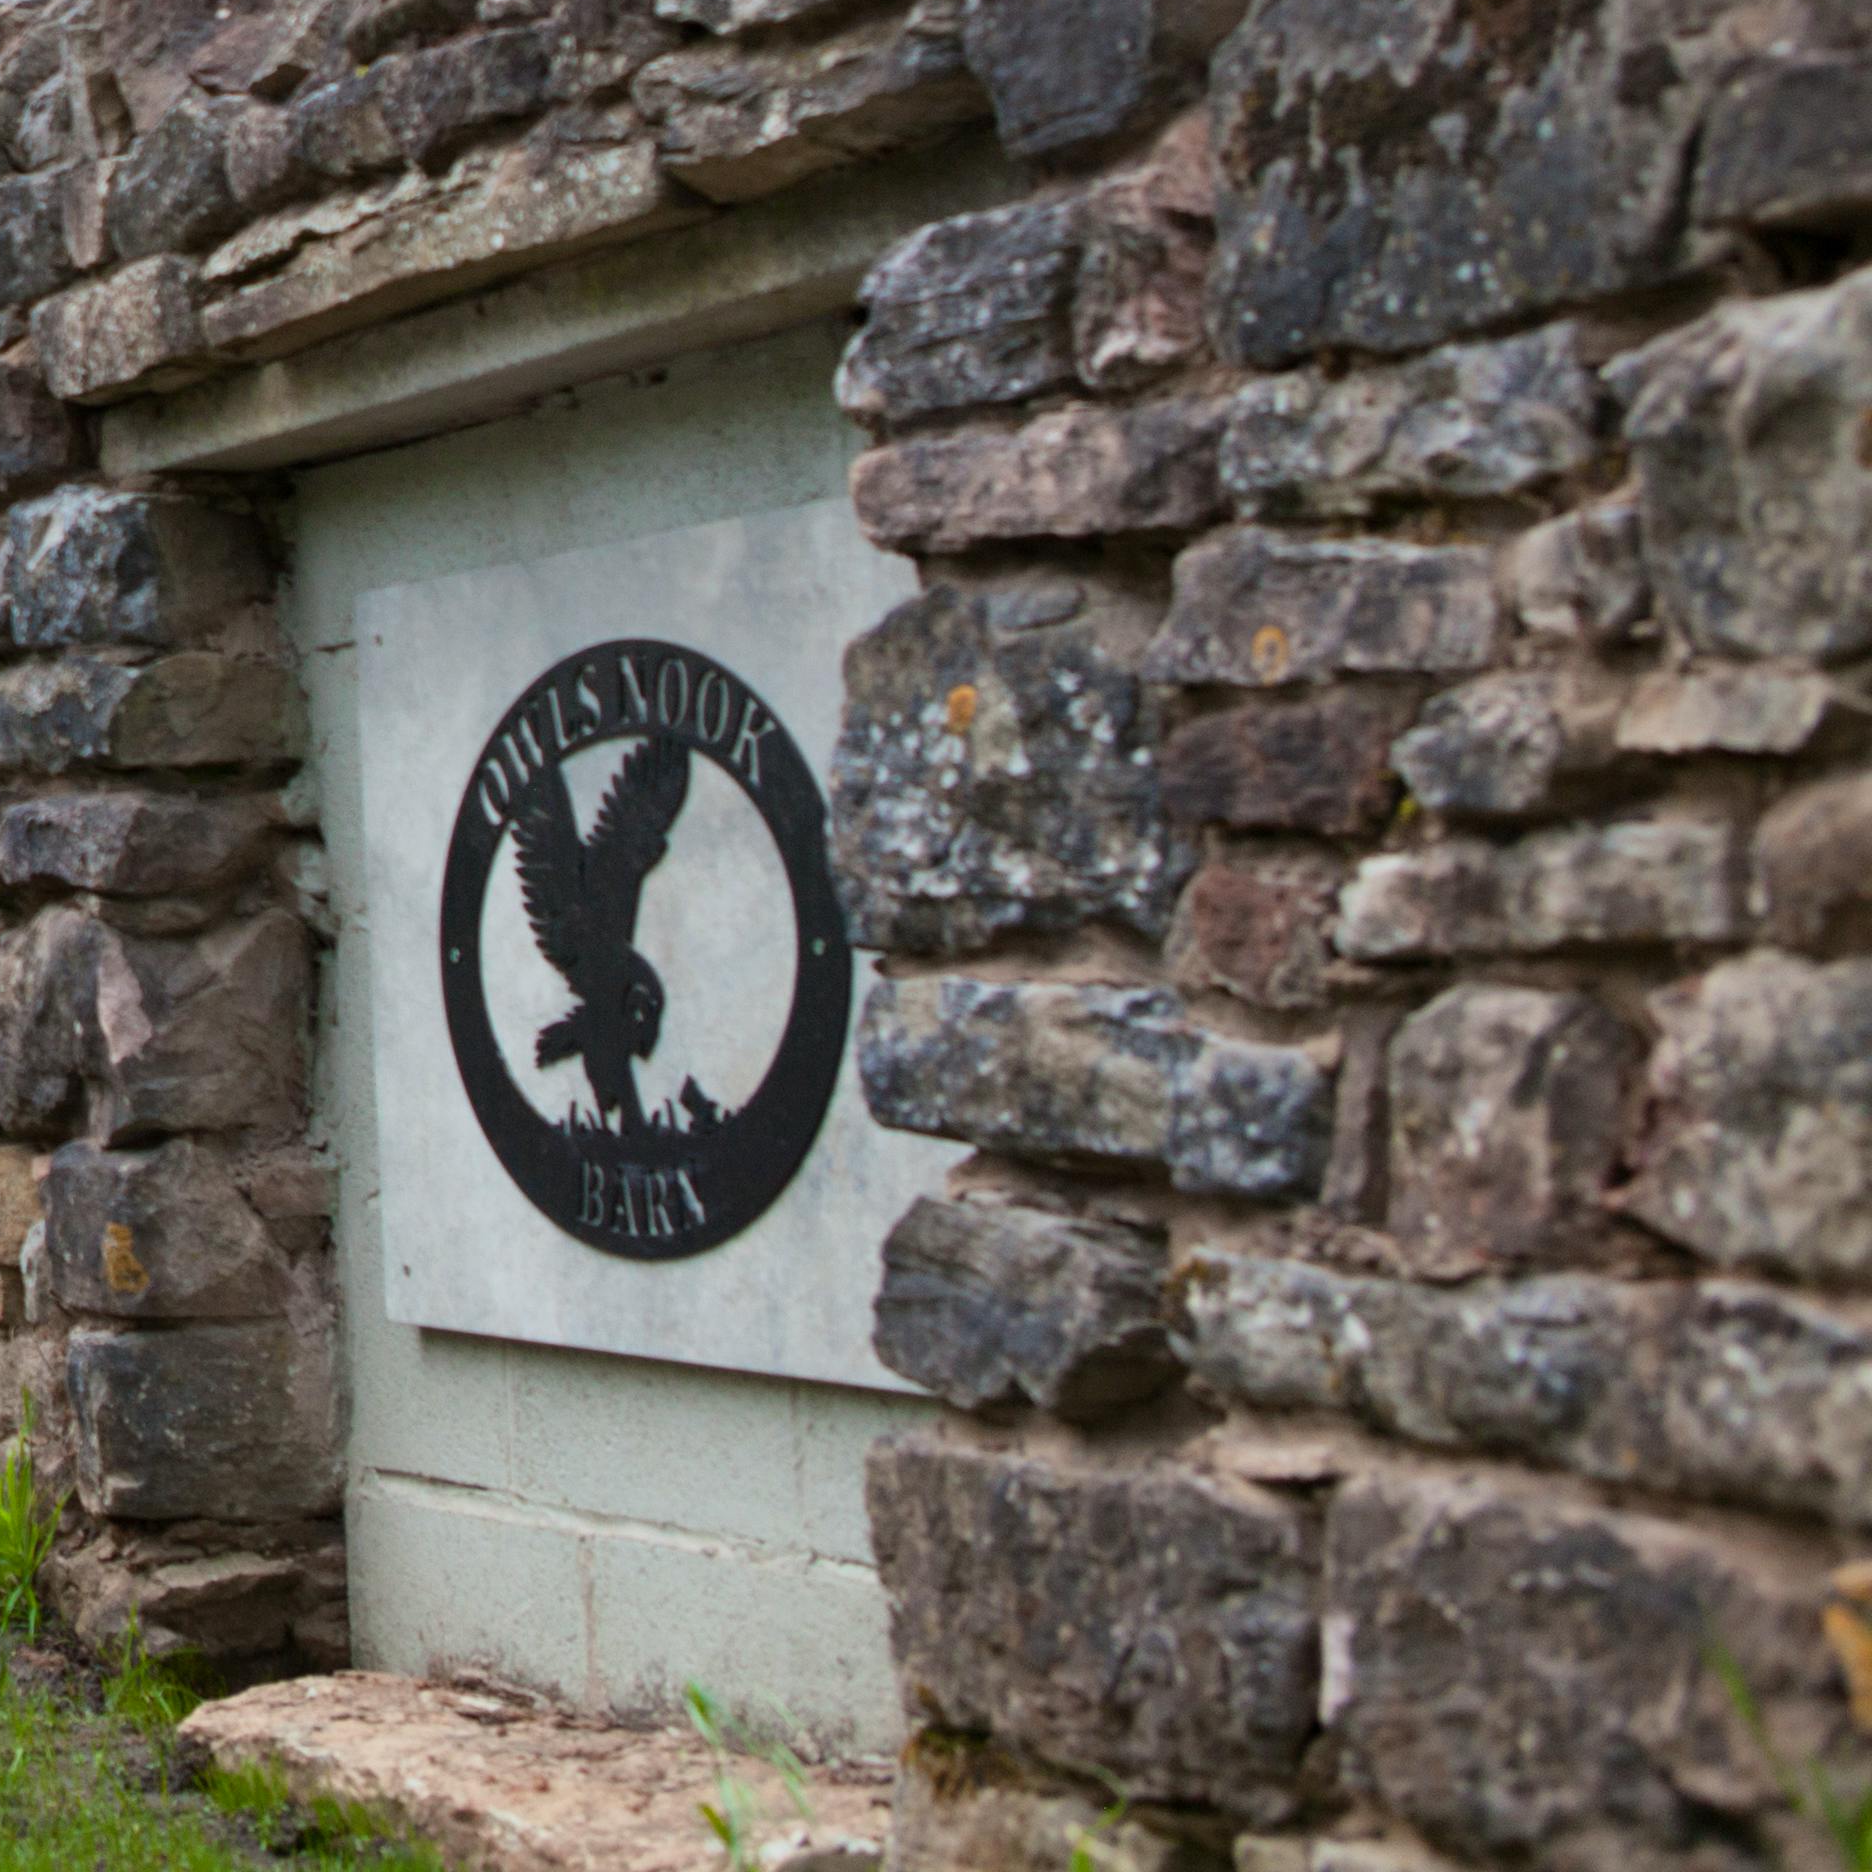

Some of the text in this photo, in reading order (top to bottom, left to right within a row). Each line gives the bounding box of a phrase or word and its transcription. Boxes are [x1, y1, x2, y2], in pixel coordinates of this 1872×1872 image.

[479, 656, 777, 826] OWLS NOOK
[578, 1159, 706, 1237] BARN
